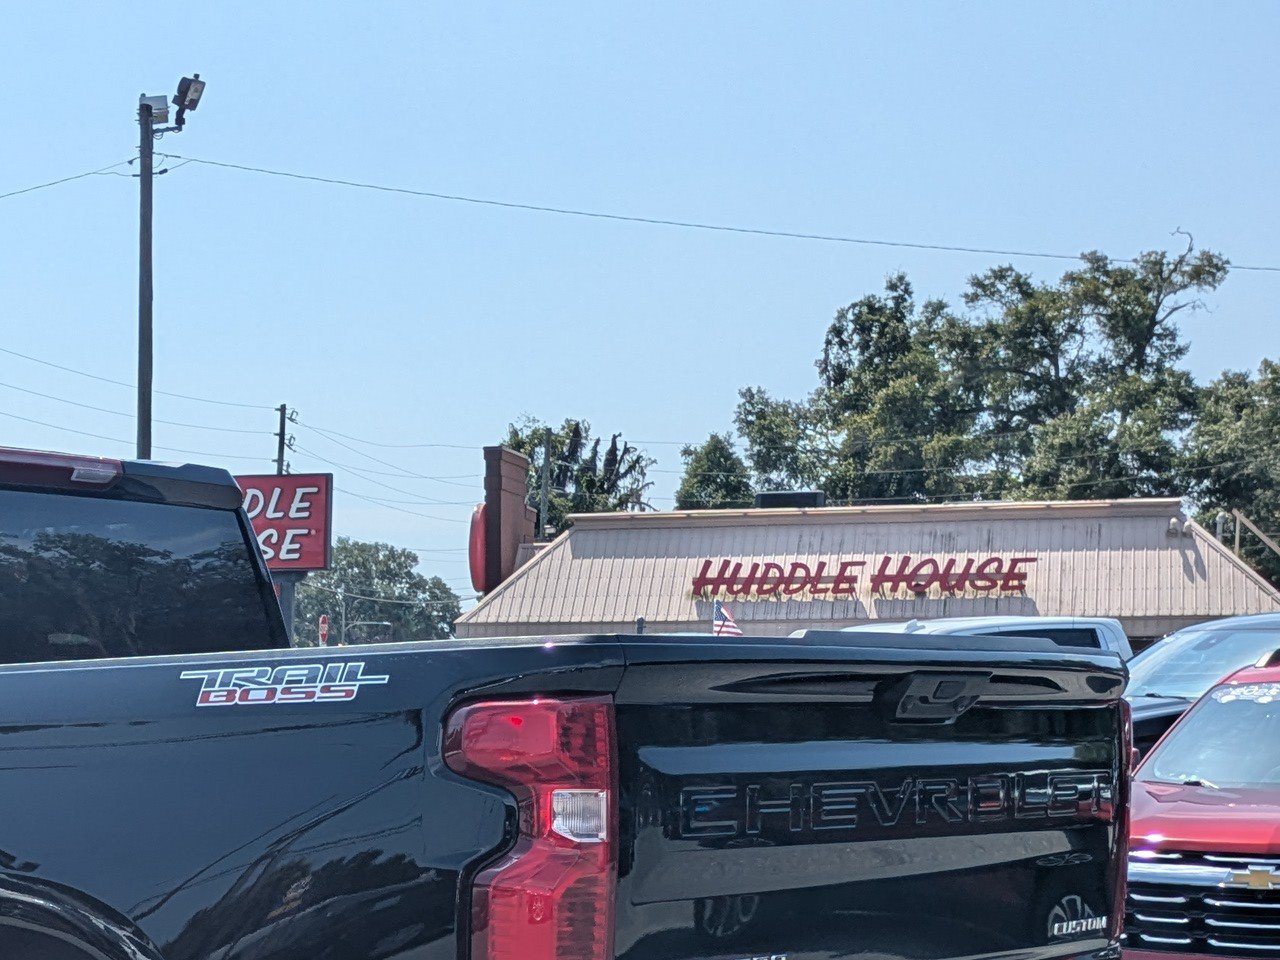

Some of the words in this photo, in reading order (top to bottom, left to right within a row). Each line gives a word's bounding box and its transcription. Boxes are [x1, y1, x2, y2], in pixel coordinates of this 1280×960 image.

[692, 559, 867, 595] HUDDLE
[870, 555, 1038, 593] HOUSE
[180, 662, 389, 688] TRAIL
[196, 684, 359, 707] BOSS
[680, 769, 1114, 838] CHEVROLET
[1053, 916, 1107, 935] CUSTOM
